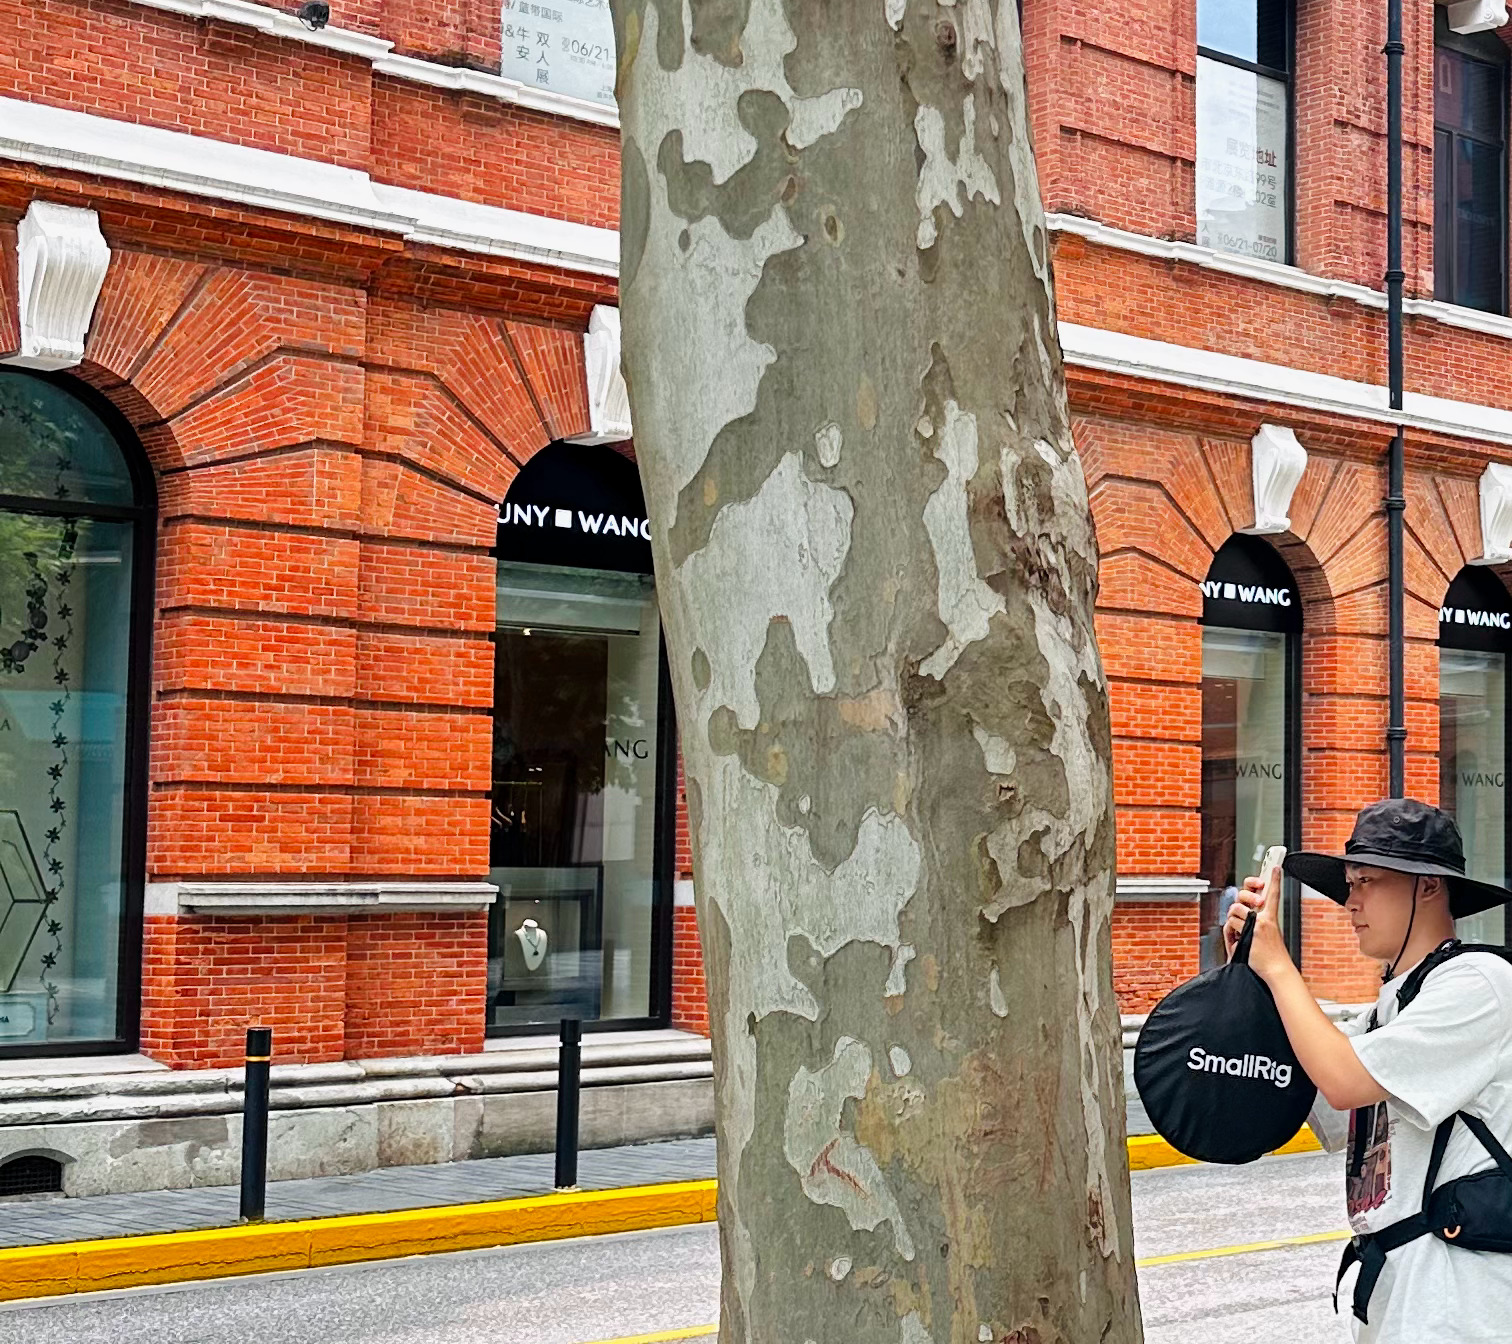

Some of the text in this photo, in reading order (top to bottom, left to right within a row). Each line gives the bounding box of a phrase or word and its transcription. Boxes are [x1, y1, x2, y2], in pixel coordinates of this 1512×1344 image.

[1238, 584, 1292, 606] WANG
[1466, 609, 1511, 629] WANG
[1462, 772, 1504, 788] WANG
[1187, 1046, 1293, 1088] SmallRig
